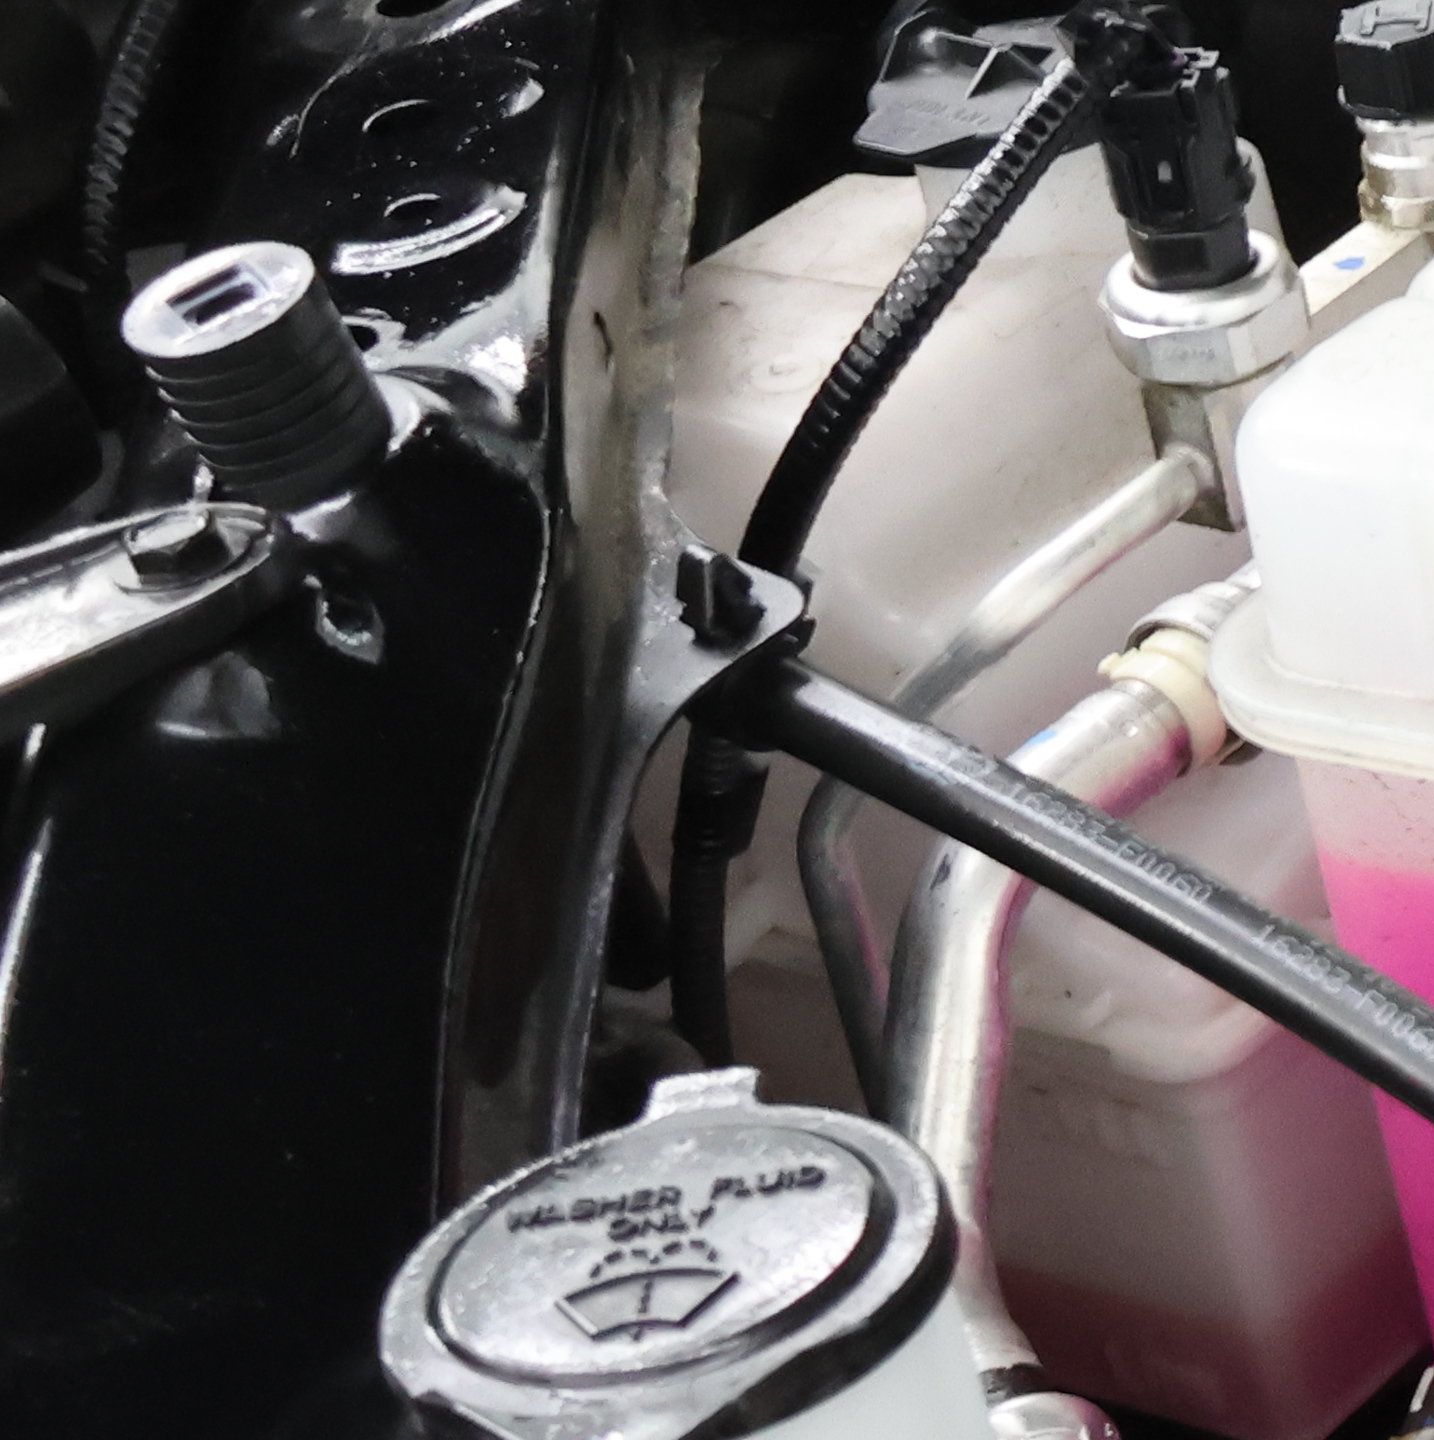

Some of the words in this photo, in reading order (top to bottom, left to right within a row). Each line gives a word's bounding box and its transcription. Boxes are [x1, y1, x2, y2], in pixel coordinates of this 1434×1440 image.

[507, 1185, 683, 1234] WASHER
[709, 1165, 828, 1201] FLUID
[608, 1205, 717, 1242] ONLY
